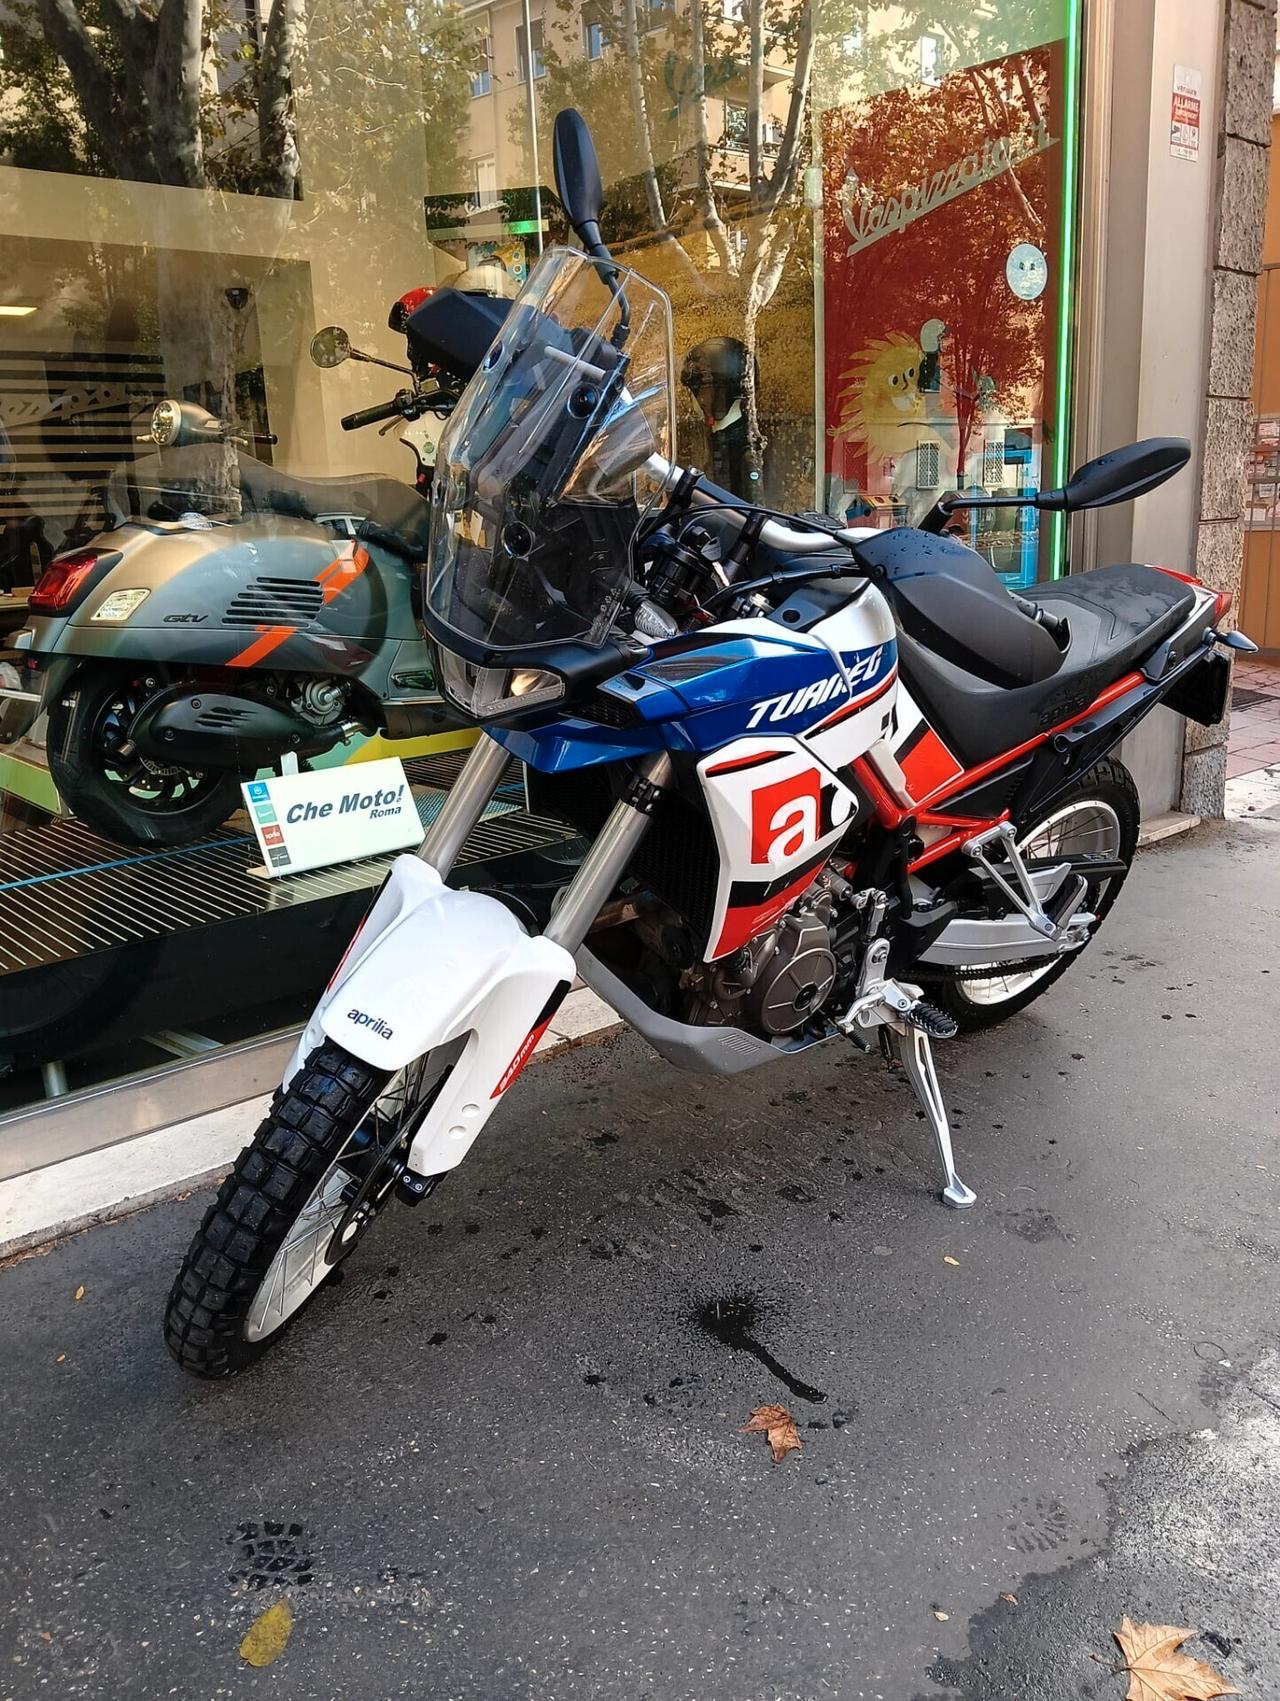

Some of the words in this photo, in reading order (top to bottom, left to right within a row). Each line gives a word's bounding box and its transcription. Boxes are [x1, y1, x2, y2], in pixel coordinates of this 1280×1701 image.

[286, 801, 334, 824] Che
[338, 784, 405, 815] Moto!
[369, 805, 402, 820] Roma
[347, 1009, 393, 1040] aprilia
